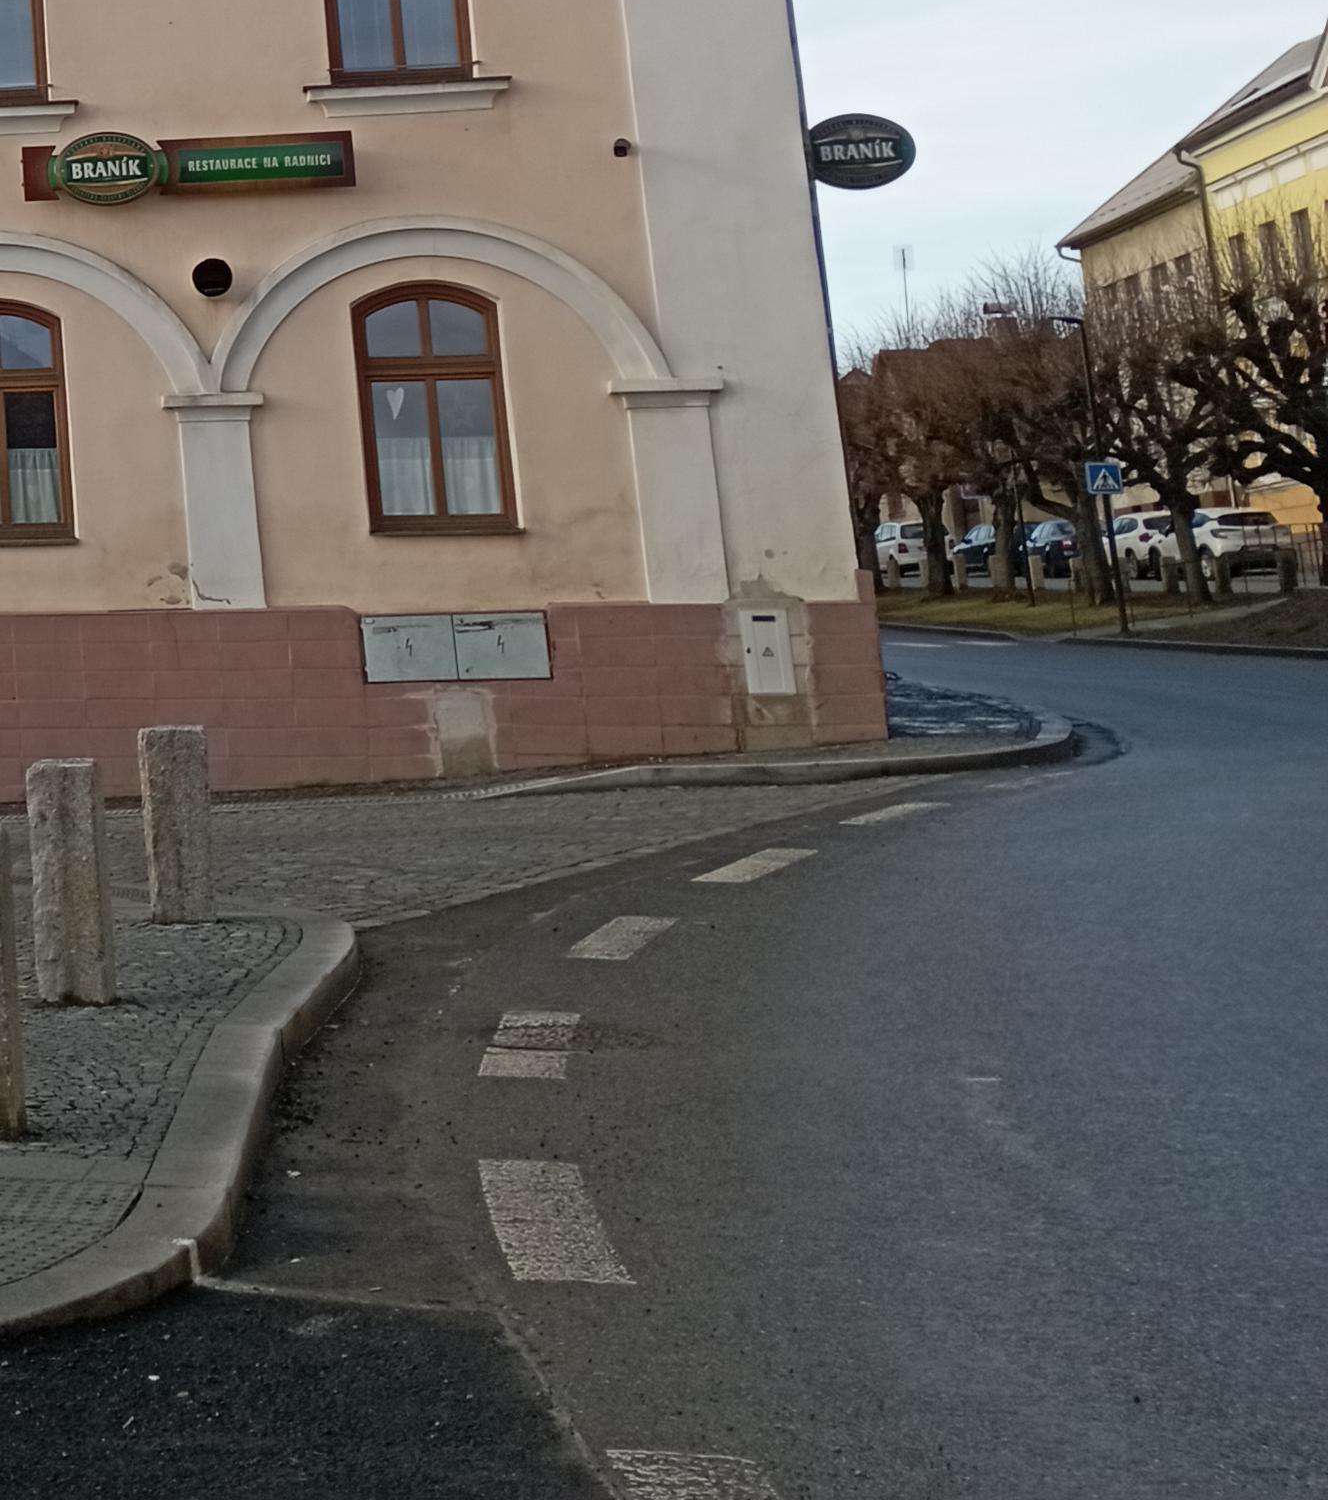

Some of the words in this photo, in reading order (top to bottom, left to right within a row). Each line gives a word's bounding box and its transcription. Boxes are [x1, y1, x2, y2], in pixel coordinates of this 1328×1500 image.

[819, 138, 896, 162] BRANÍK
[71, 155, 142, 180] BRANÍK
[187, 157, 258, 172] RESTAURACE
[263, 156, 279, 168] NA
[284, 153, 331, 167] RADNICI
